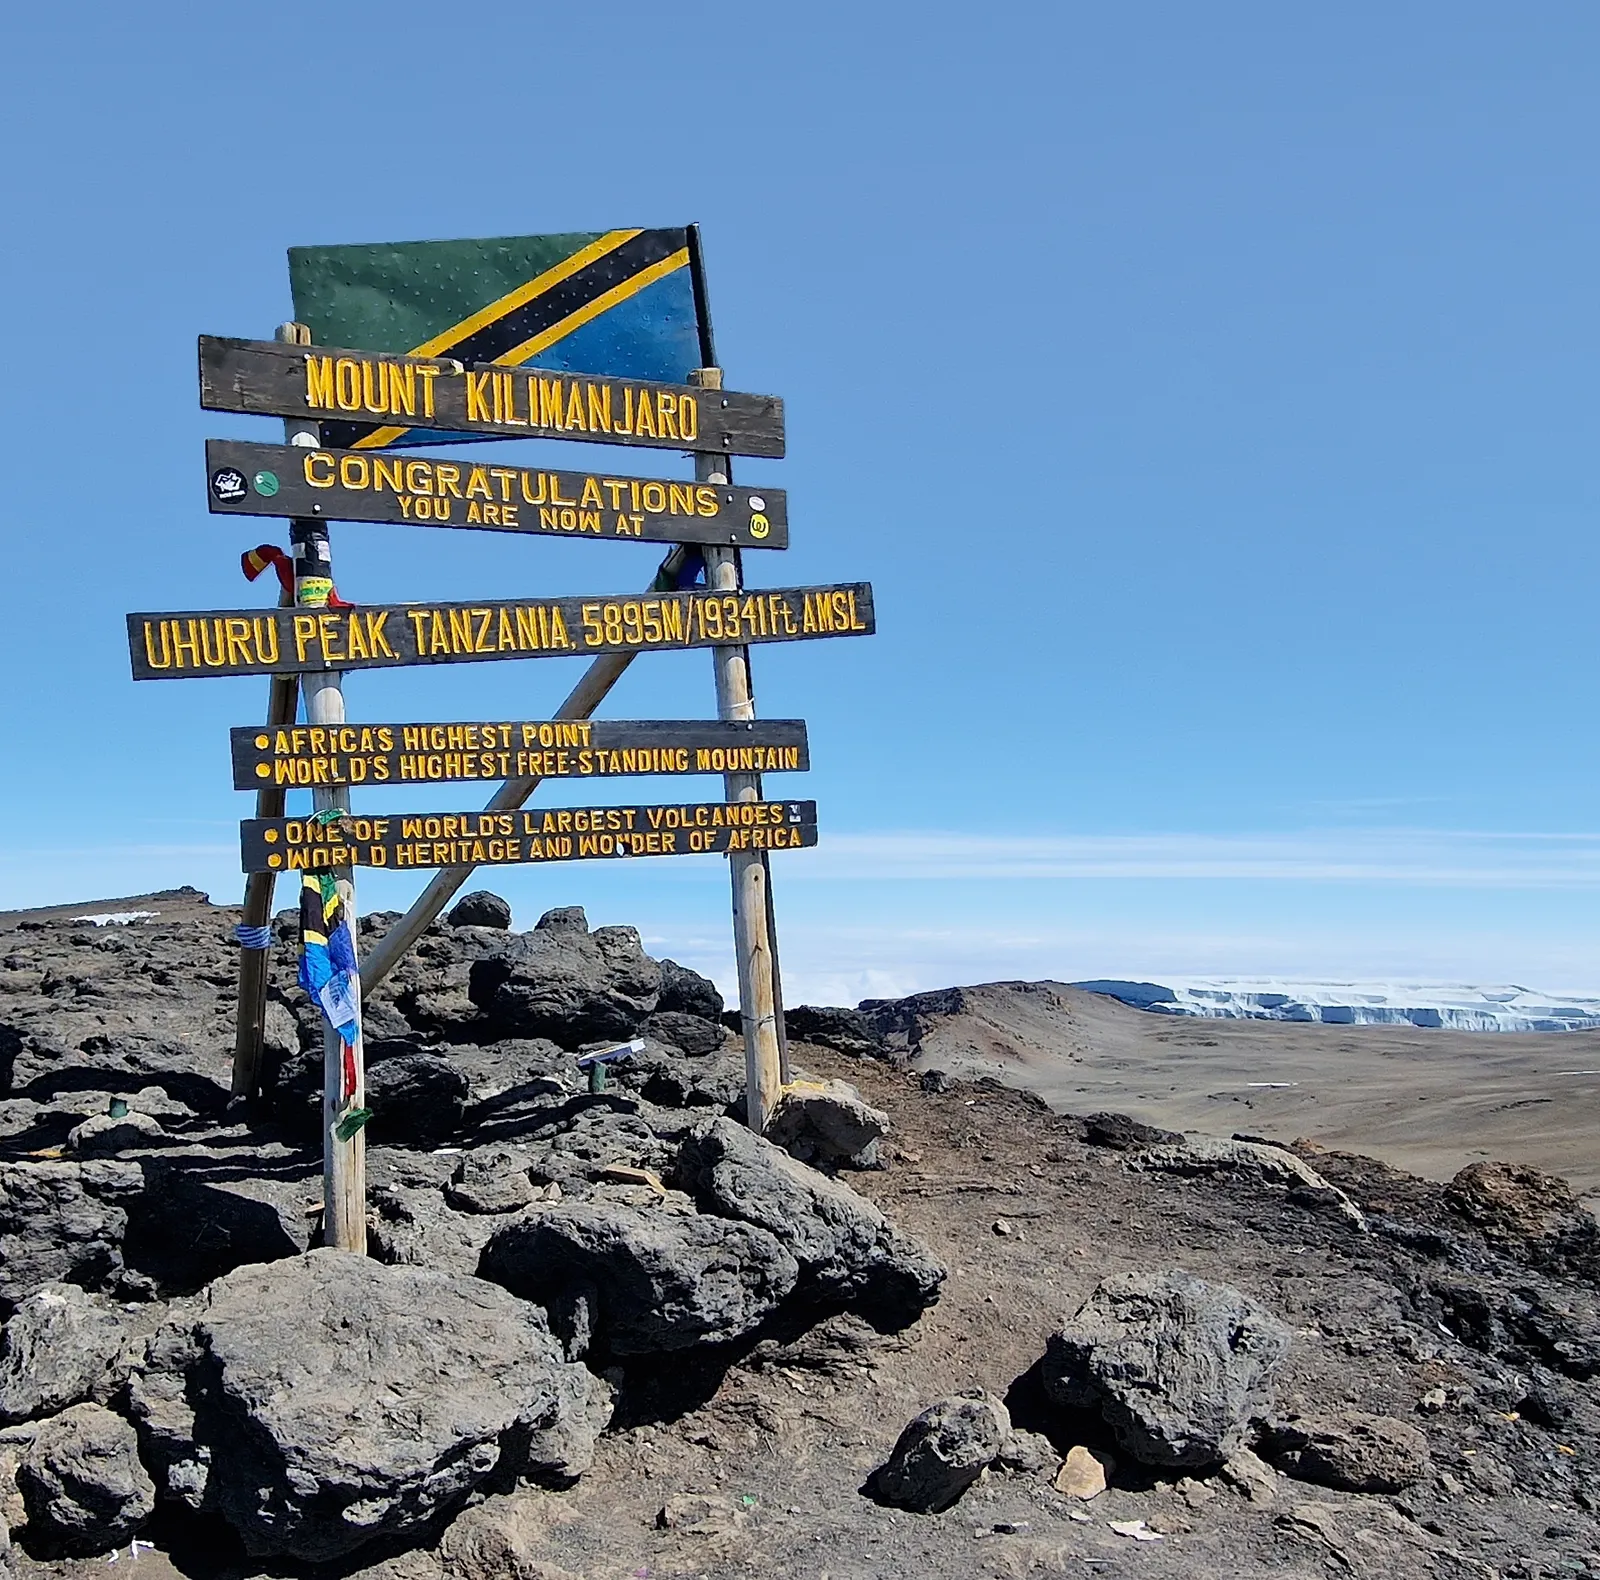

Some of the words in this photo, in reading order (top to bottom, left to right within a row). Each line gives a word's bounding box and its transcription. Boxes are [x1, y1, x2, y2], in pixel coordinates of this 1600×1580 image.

[307, 355, 440, 418] MOUNT
[466, 371, 697, 441] KILIMANJARO
[304, 452, 719, 518] CONGRATULATIONS
[397, 496, 450, 520] YOU
[467, 502, 518, 527] ARE
[540, 507, 601, 533] NOW
[616, 514, 644, 536] AT
[143, 616, 280, 668] UHURU
[293, 611, 400, 662] PEAK,
[407, 606, 577, 656] TANZANIA,
[803, 590, 866, 632] AMSL
[274, 727, 394, 755] AFRICA'S
[403, 724, 512, 751] HIGHEST
[522, 724, 592, 748] POINT
[274, 755, 390, 785] WORLD'S
[399, 752, 510, 780] HIGHEST
[517, 749, 689, 776] FREE-STANDING
[696, 746, 799, 772] MOUNTAIN
[286, 821, 343, 844] ONE
[355, 819, 390, 840] OF
[401, 814, 514, 839] WORLD'S
[523, 810, 636, 835] LARGEST
[647, 804, 783, 829] VOLCANOES
[396, 839, 521, 866] HERITAGE
[530, 837, 572, 859] AND
[689, 830, 717, 851] OF
[728, 827, 802, 849] AFRICA
